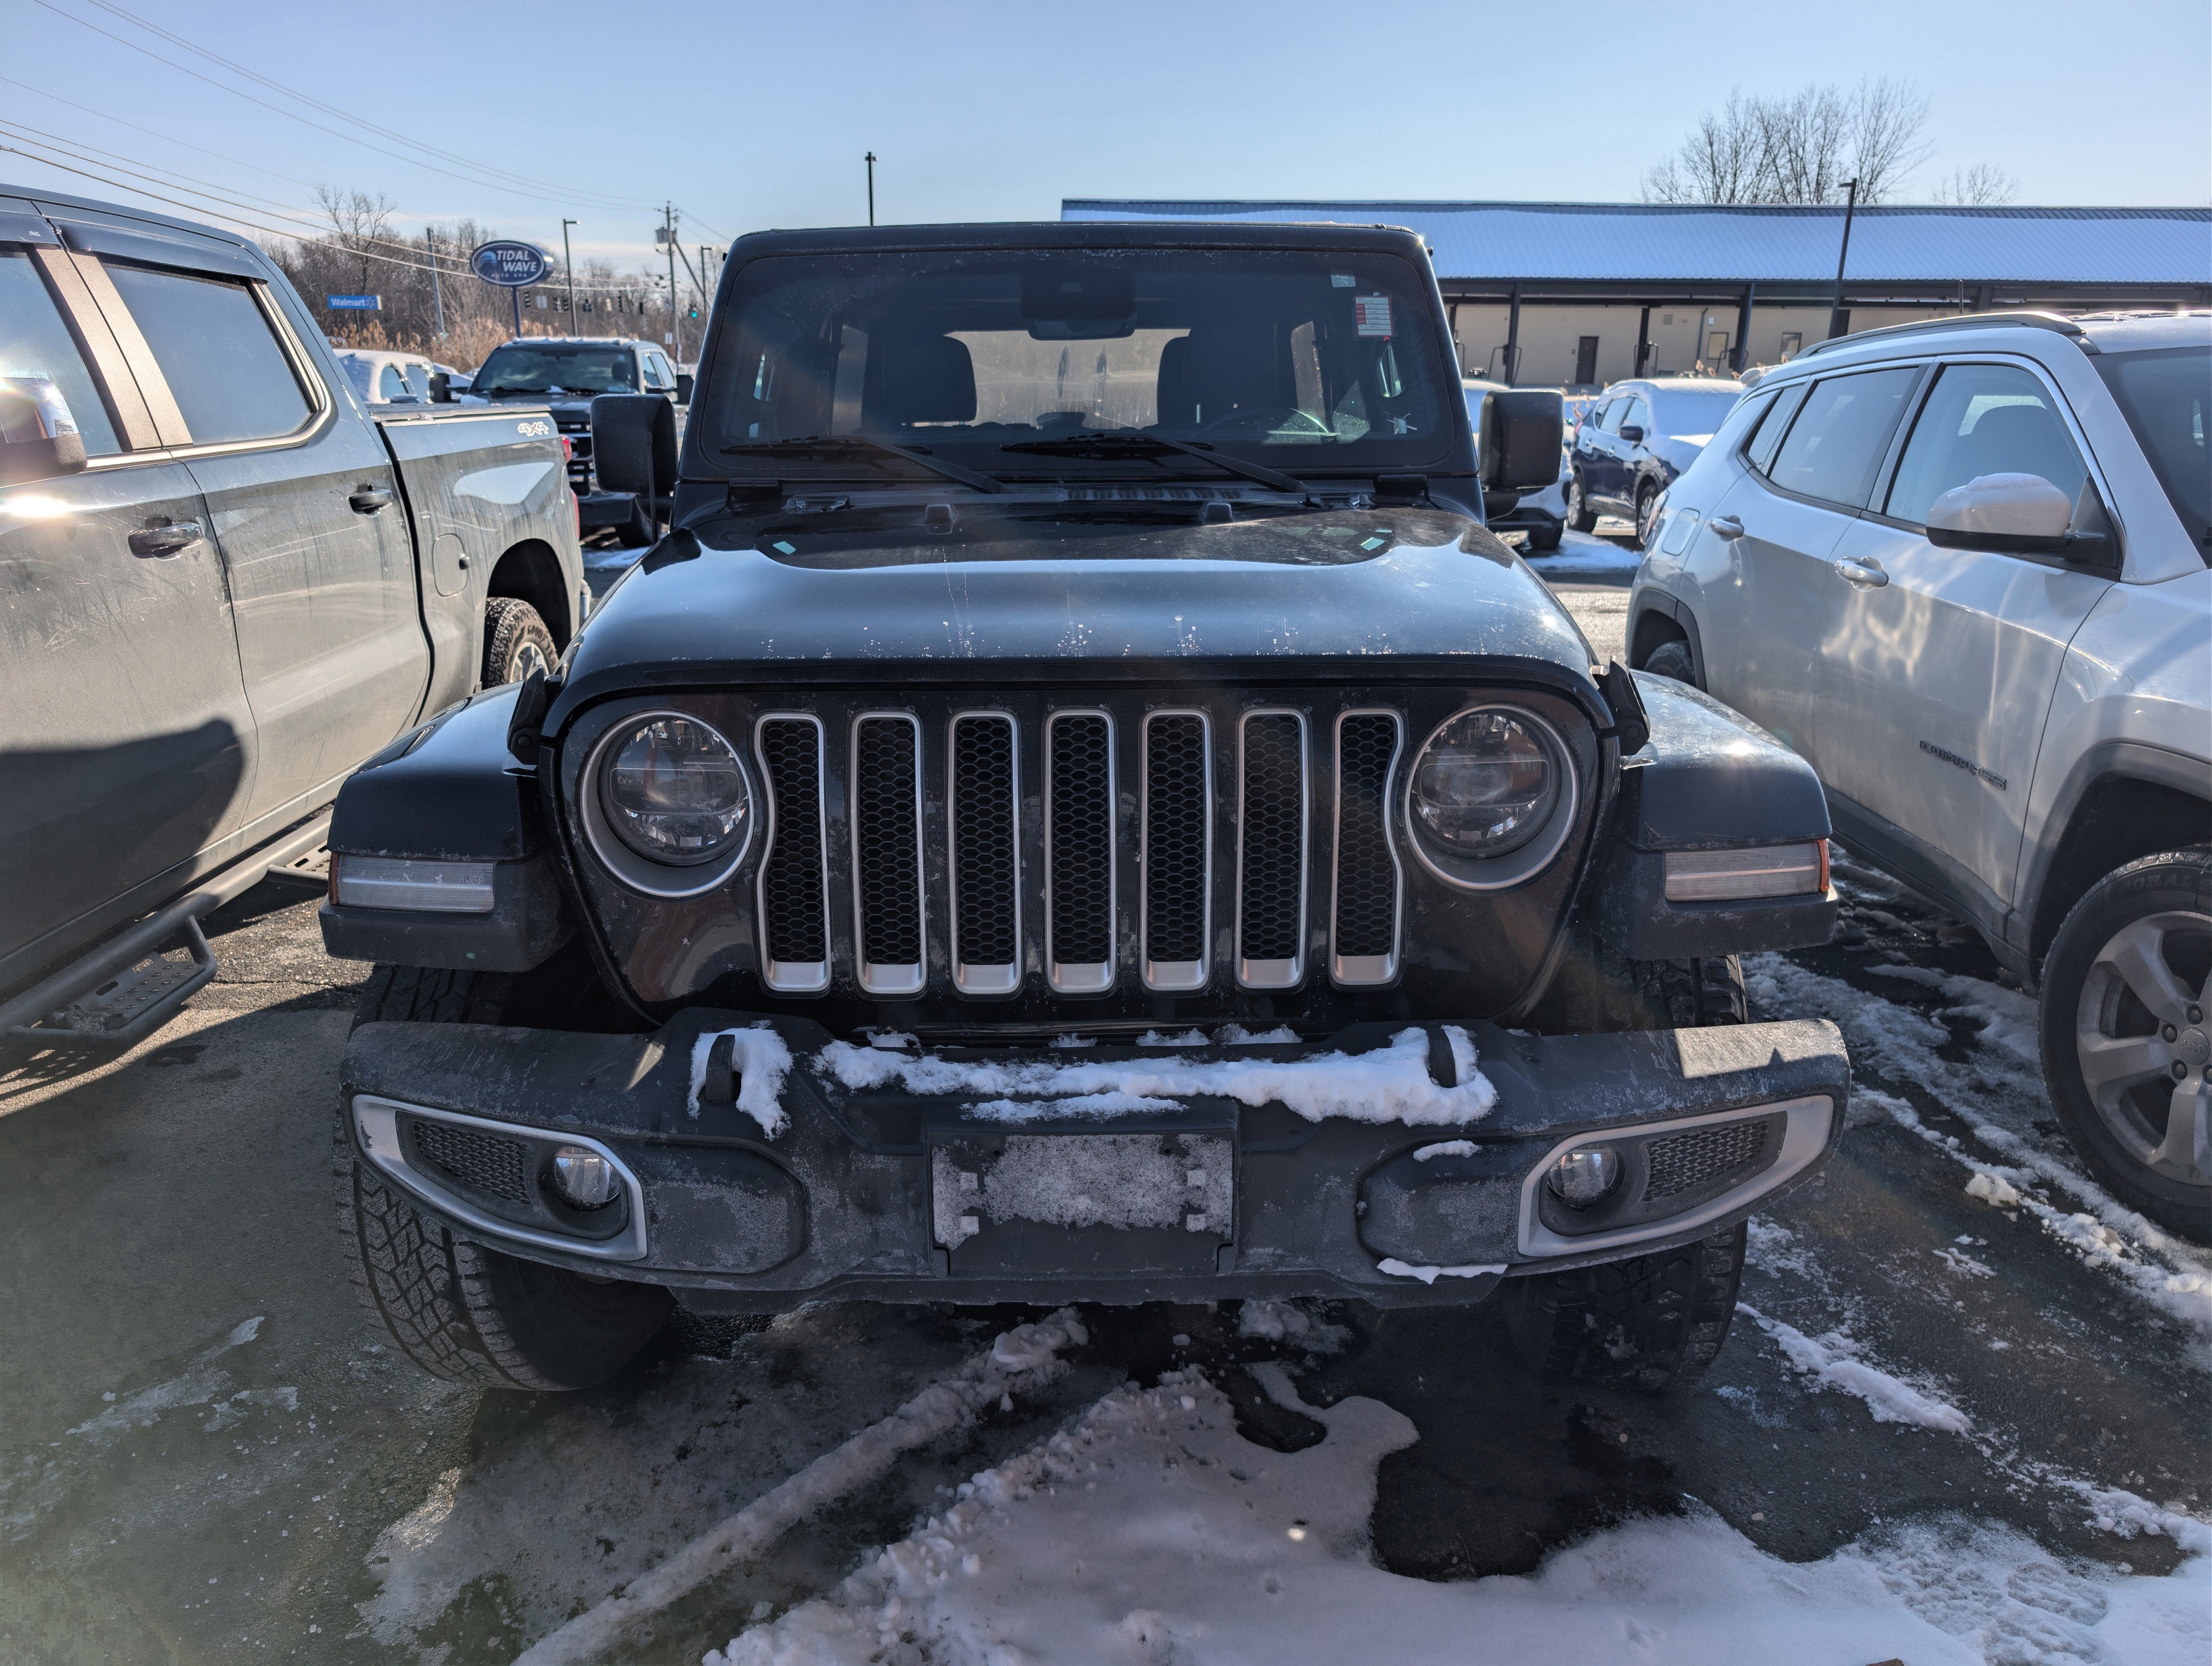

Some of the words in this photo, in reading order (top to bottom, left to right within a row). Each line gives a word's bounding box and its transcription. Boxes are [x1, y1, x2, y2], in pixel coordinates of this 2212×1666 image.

[497, 250, 530, 261] TIDAL
[503, 261, 537, 272] WAVE
[331, 298, 366, 307] Walmart
[1920, 740, 2007, 790] COMPASS
[2180, 1040, 2205, 1054] Jeep
